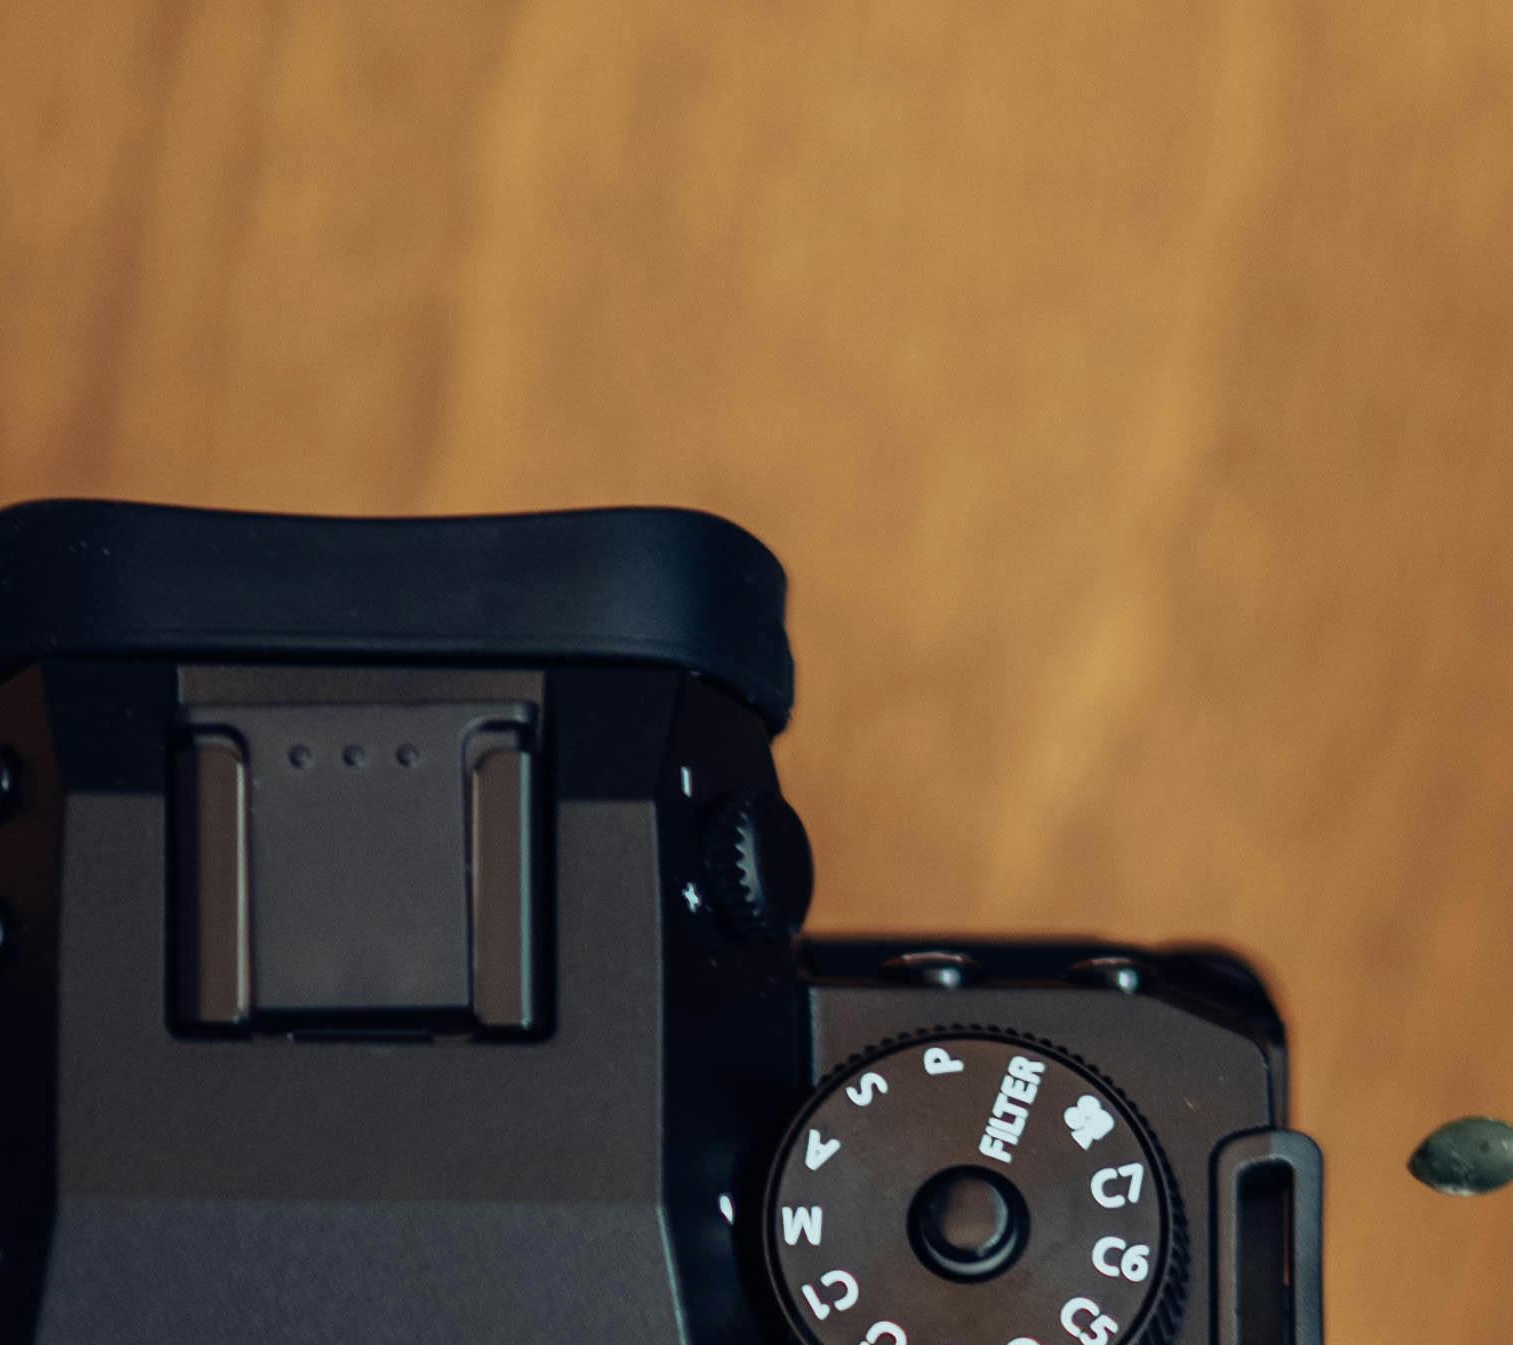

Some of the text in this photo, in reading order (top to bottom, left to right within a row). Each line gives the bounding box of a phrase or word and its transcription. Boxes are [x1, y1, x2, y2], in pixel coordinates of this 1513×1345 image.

[923, 1047, 965, 1076] P
[846, 1071, 889, 1107] S
[978, 1055, 1046, 1164] FILTER
[804, 1128, 841, 1171] A
[1090, 1162, 1144, 1209] C7
[781, 1205, 823, 1247] M
[1091, 1236, 1151, 1282] C6
[801, 1269, 860, 1320] C1
